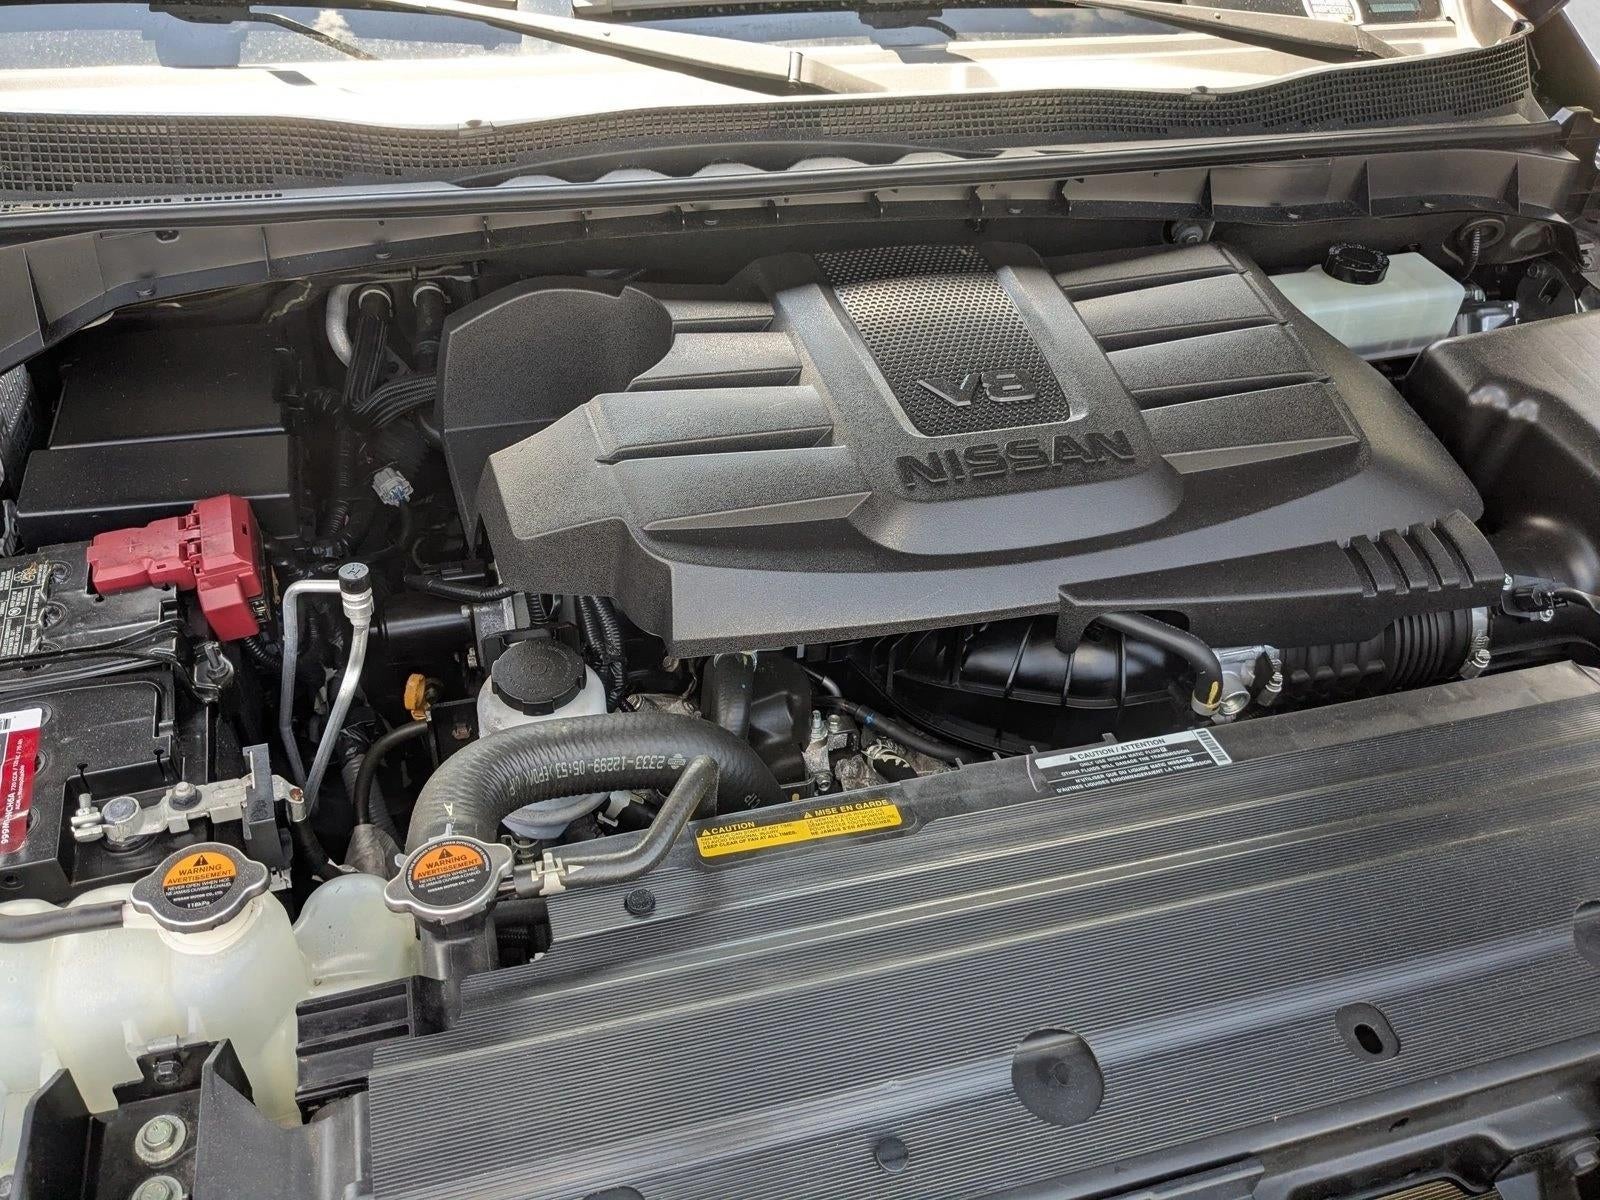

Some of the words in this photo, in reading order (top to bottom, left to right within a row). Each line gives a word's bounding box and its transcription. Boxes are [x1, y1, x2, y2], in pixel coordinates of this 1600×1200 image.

[916, 369, 1039, 406] V8
[896, 430, 1135, 488] NISSAN
[1077, 748, 1114, 760] CAUTION
[1120, 738, 1165, 752] ATTENTION
[814, 807, 838, 816] MISE
[854, 799, 888, 810] GARDE
[710, 822, 755, 834] CAUTION
[179, 864, 222, 876] WARNING
[417, 858, 478, 878] AVERTISSEMENT
[425, 854, 468, 869] WARNING
[168, 870, 232, 884] AVERTISSEMENT
